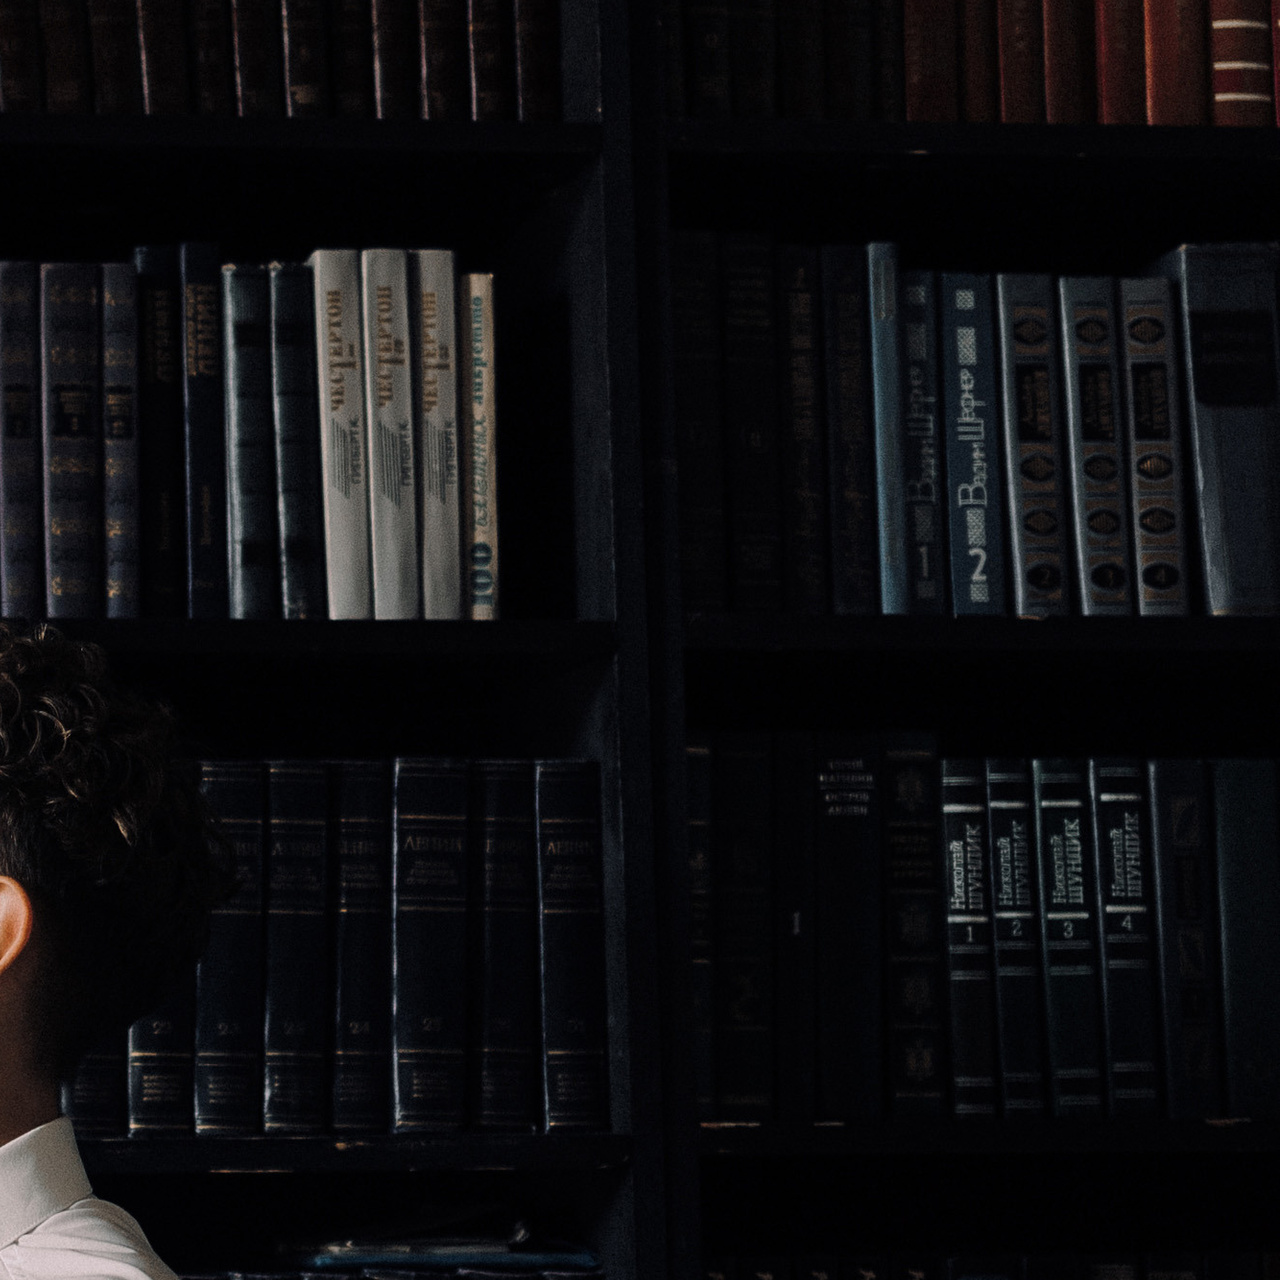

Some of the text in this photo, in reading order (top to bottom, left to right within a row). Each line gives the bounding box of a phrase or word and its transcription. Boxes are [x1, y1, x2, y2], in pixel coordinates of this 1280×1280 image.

[470, 542, 494, 608] 100
[920, 545, 930, 578] 1
[967, 546, 988, 583] 2
[948, 839, 967, 912] Николай
[963, 822, 986, 911] ШУНДИК
[995, 835, 1014, 908] Николай
[1011, 818, 1032, 907] ШУНДИК
[1048, 833, 1068, 906] Николай
[1063, 816, 1086, 905] ШУНДИК
[1107, 827, 1126, 899] Николай
[1124, 810, 1145, 899] ШУНДИК
[965, 924, 976, 944] 1
[1010, 919, 1024, 938] 2
[1062, 920, 1076, 939] 3
[1119, 914, 1134, 932] 4
